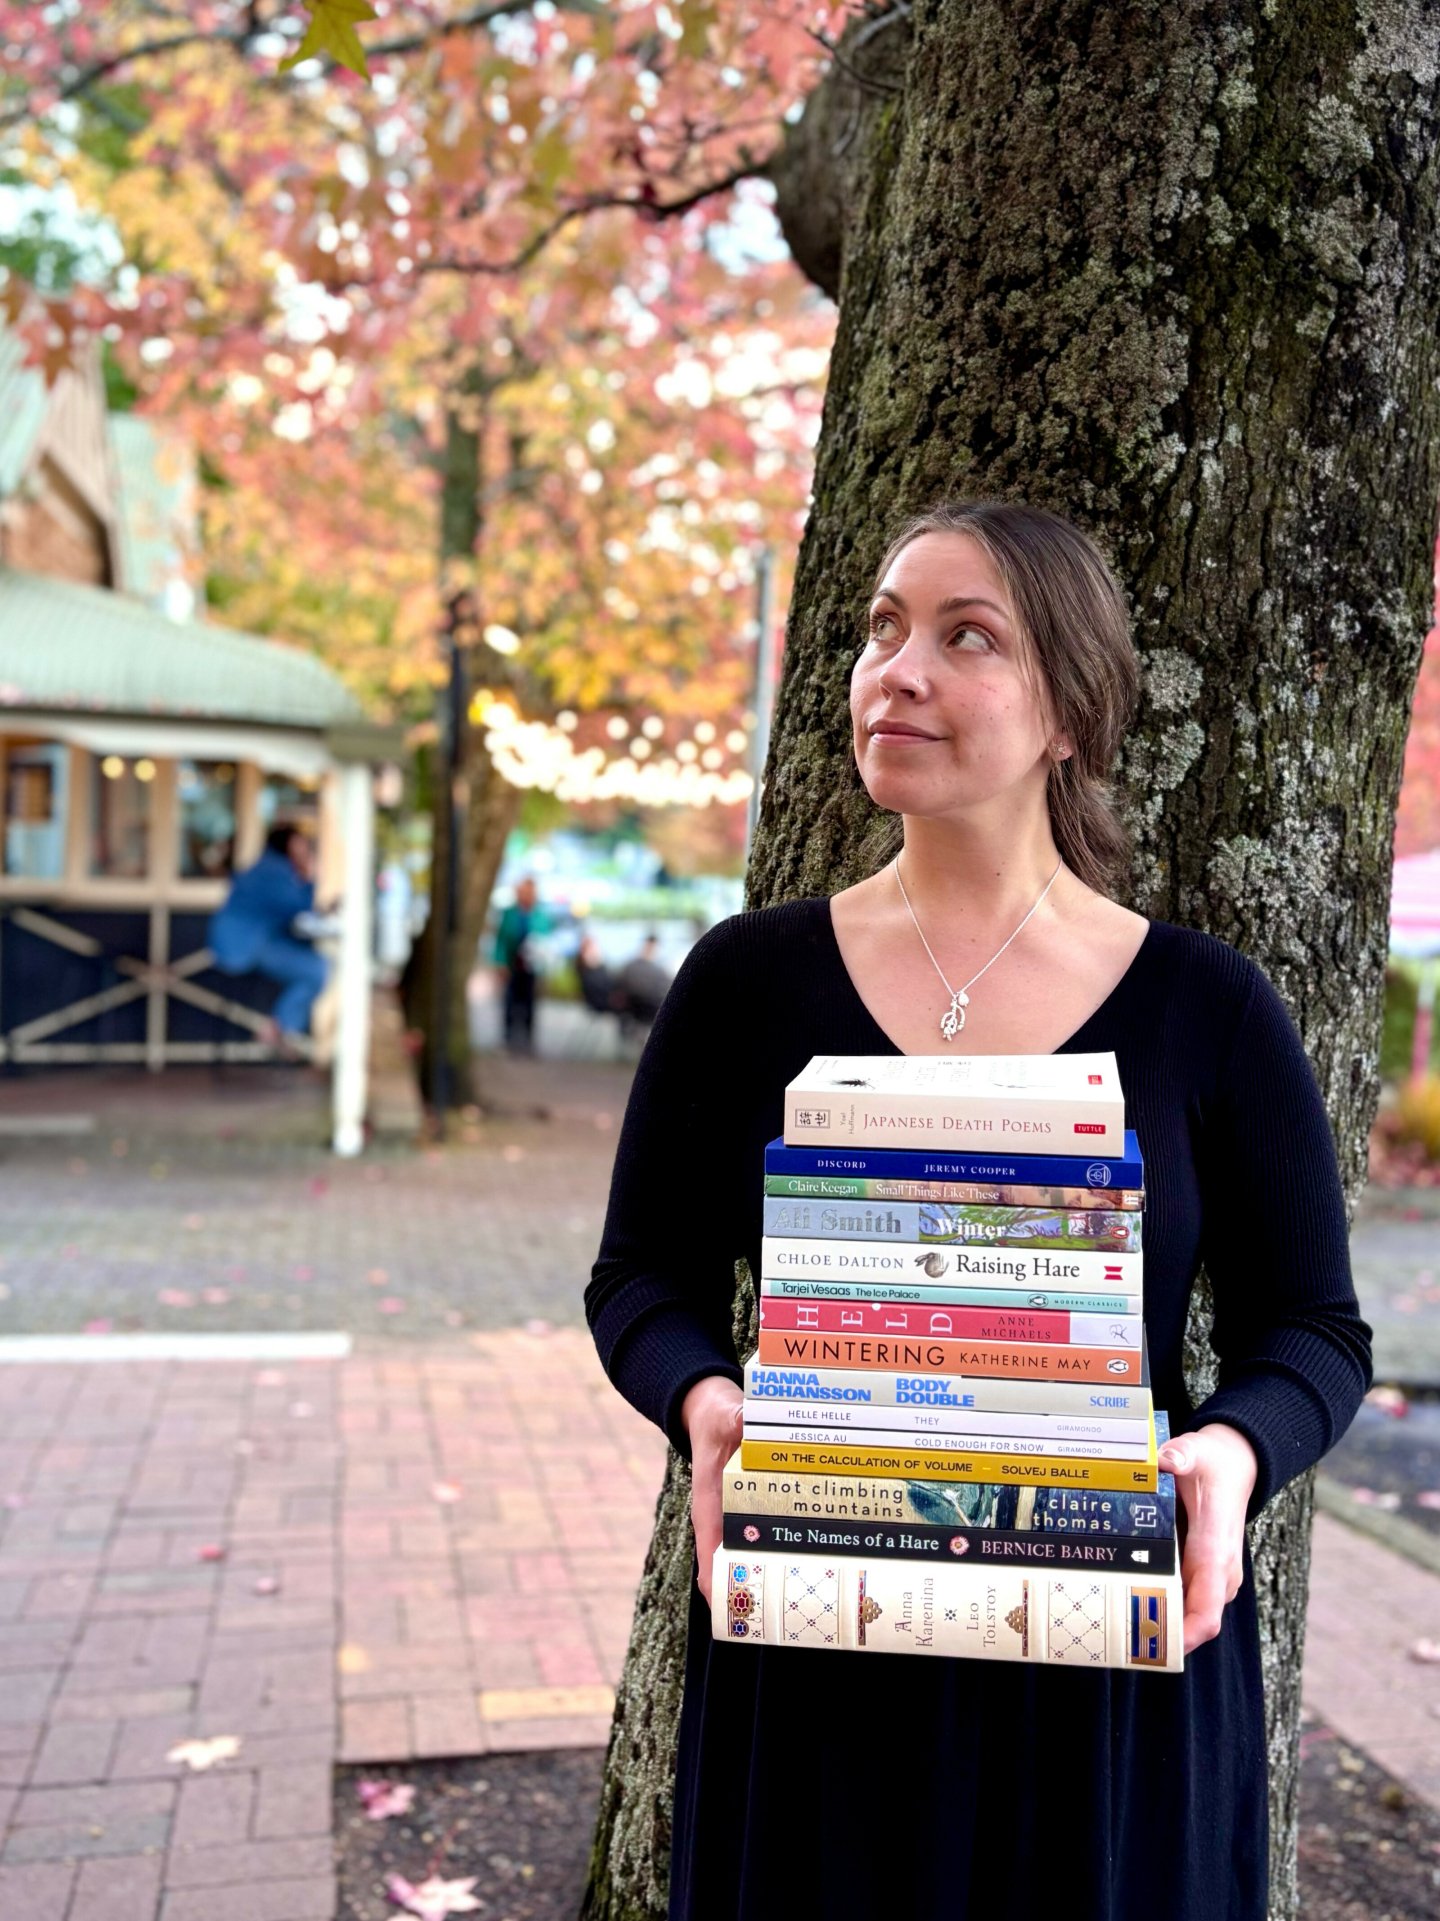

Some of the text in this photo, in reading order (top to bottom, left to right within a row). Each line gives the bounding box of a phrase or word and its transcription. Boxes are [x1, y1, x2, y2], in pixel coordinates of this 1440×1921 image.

[863, 1114, 1052, 1133] JAPANESE DEATH POEMS
[1078, 1125, 1103, 1133] TUTTLE
[817, 1159, 867, 1169] DISCORD
[924, 1164, 1016, 1176] JEREMY COOPER
[788, 1180, 858, 1196] Claire Keegan
[876, 1183, 1000, 1200] Small Things Like These
[772, 1206, 902, 1234] Ali Smith
[937, 1217, 1007, 1237] Winter
[777, 1253, 904, 1269] CHLOE DALTON
[956, 1254, 1080, 1282] Raising Hare
[781, 1282, 850, 1296] Tarjei Vesaas
[856, 1288, 920, 1299] The Ice Palace
[1088, 1300, 1123, 1308] CLASSICS
[998, 1316, 1034, 1327] ANNE
[981, 1328, 1051, 1340] MICHAELS
[784, 1338, 945, 1366] WINTERING
[960, 1352, 1092, 1370] KATHERINE MAY
[752, 1370, 820, 1386] HANNA
[896, 1378, 952, 1392] BODY
[752, 1384, 872, 1402] JOHANSSON
[896, 1392, 974, 1407] DOUBLE
[1090, 1395, 1130, 1408] SCRIBE
[788, 1410, 852, 1421] HELLE HELLE
[914, 1416, 940, 1426] THEY
[1056, 1424, 1102, 1434] GIRAMONDO
[789, 1432, 847, 1443] JESSICA AU
[914, 1438, 1044, 1452] COLD ENOUGH FOR SNOW
[1058, 1446, 1103, 1454] GIRAMONDO
[771, 1452, 973, 1472] ON THE CALCULATION OF VOLUME
[1001, 1464, 1090, 1479] SOLVEJ BALLE
[734, 1480, 904, 1504] on not climbing
[794, 1501, 904, 1518] mountains
[1050, 1494, 1112, 1512] claire
[1033, 1513, 1112, 1530] thomas
[772, 1526, 940, 1550] The Names of a Hare
[982, 1540, 1118, 1561] BERNICE BARRY
[894, 1590, 912, 1633] Anna
[916, 1577, 934, 1648] Karenina
[966, 1602, 980, 1631] LEO
[983, 1585, 996, 1648] TOLSTOY
